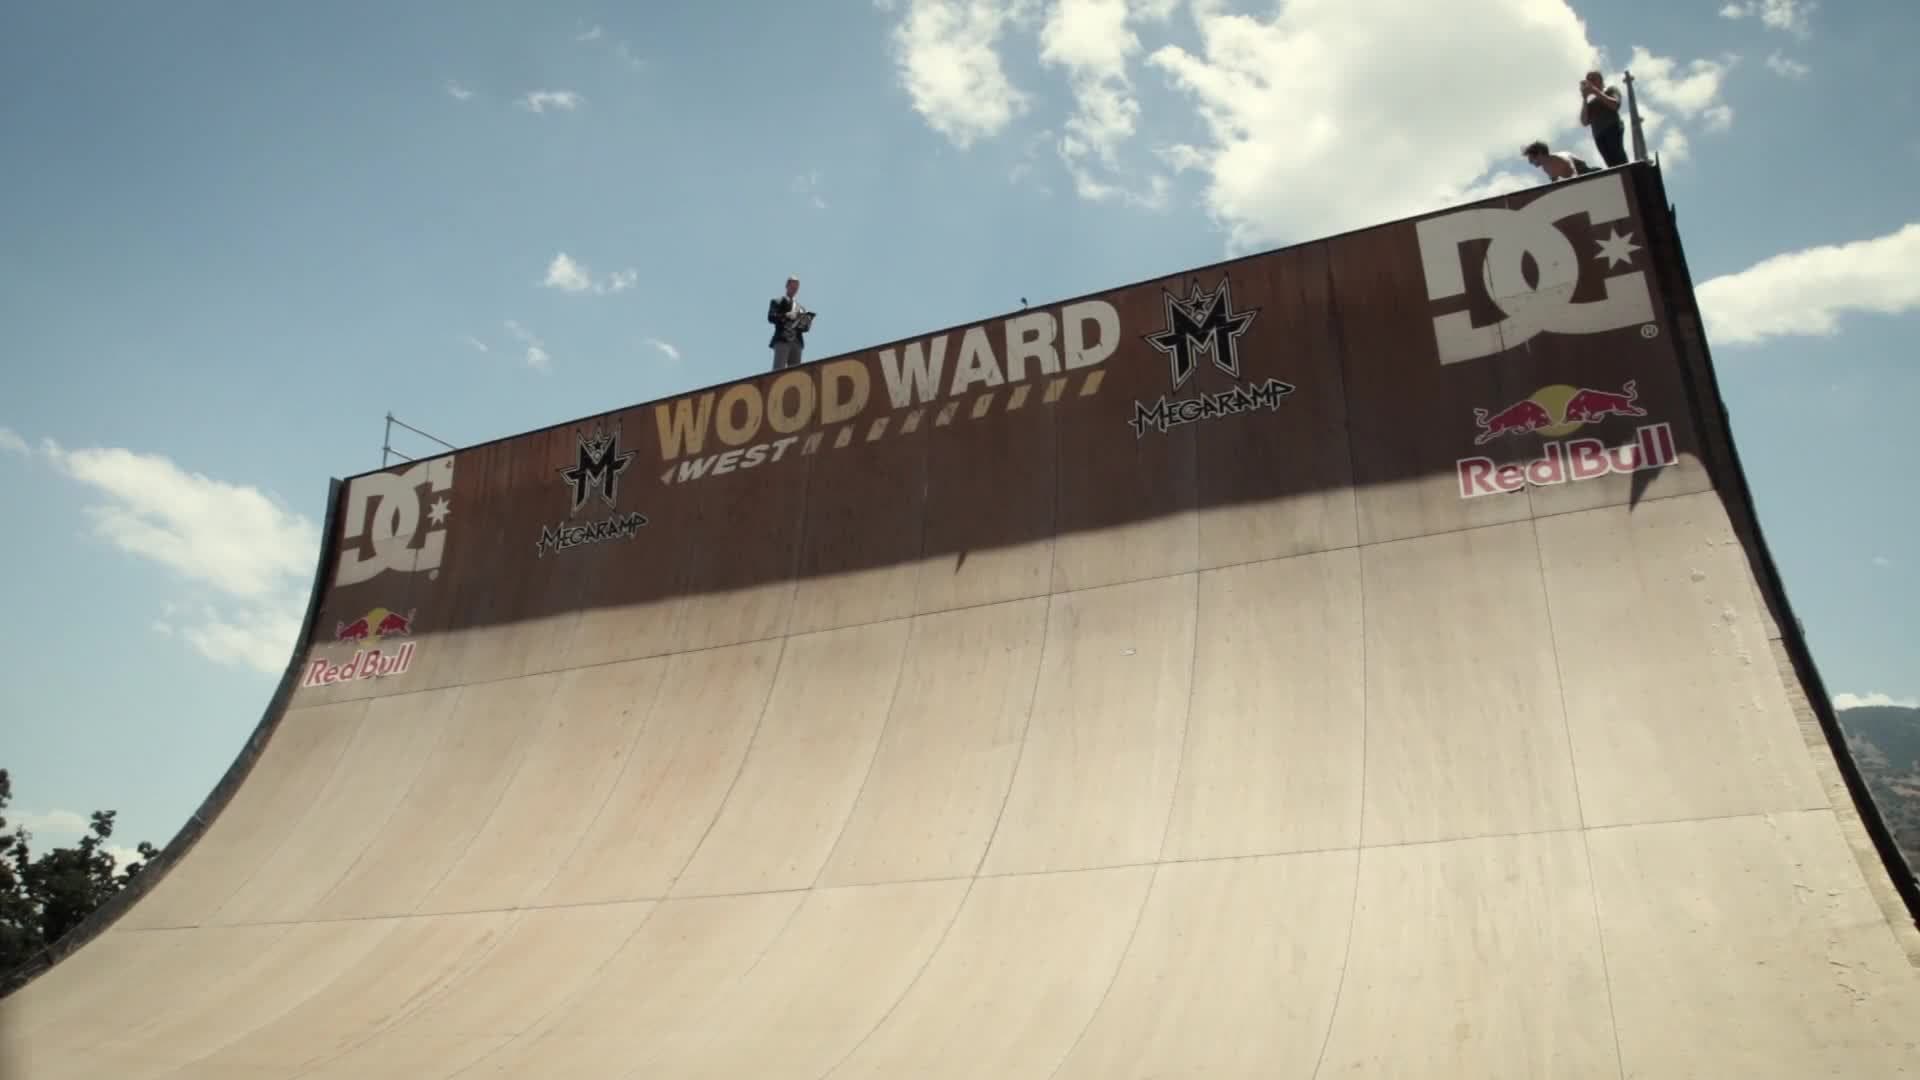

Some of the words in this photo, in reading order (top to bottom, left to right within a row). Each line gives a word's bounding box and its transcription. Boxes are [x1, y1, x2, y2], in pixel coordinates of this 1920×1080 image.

[1415, 173, 1655, 366] DC
[1128, 378, 1296, 439] MEGARAMP
[677, 435, 801, 485] WEST
[1457, 442, 1566, 499] Red
[1567, 422, 1679, 480] Bull
[335, 455, 455, 587] DC
[536, 511, 648, 558] MEGARAMP
[303, 650, 361, 687] Red
[358, 641, 416, 679] Bull
